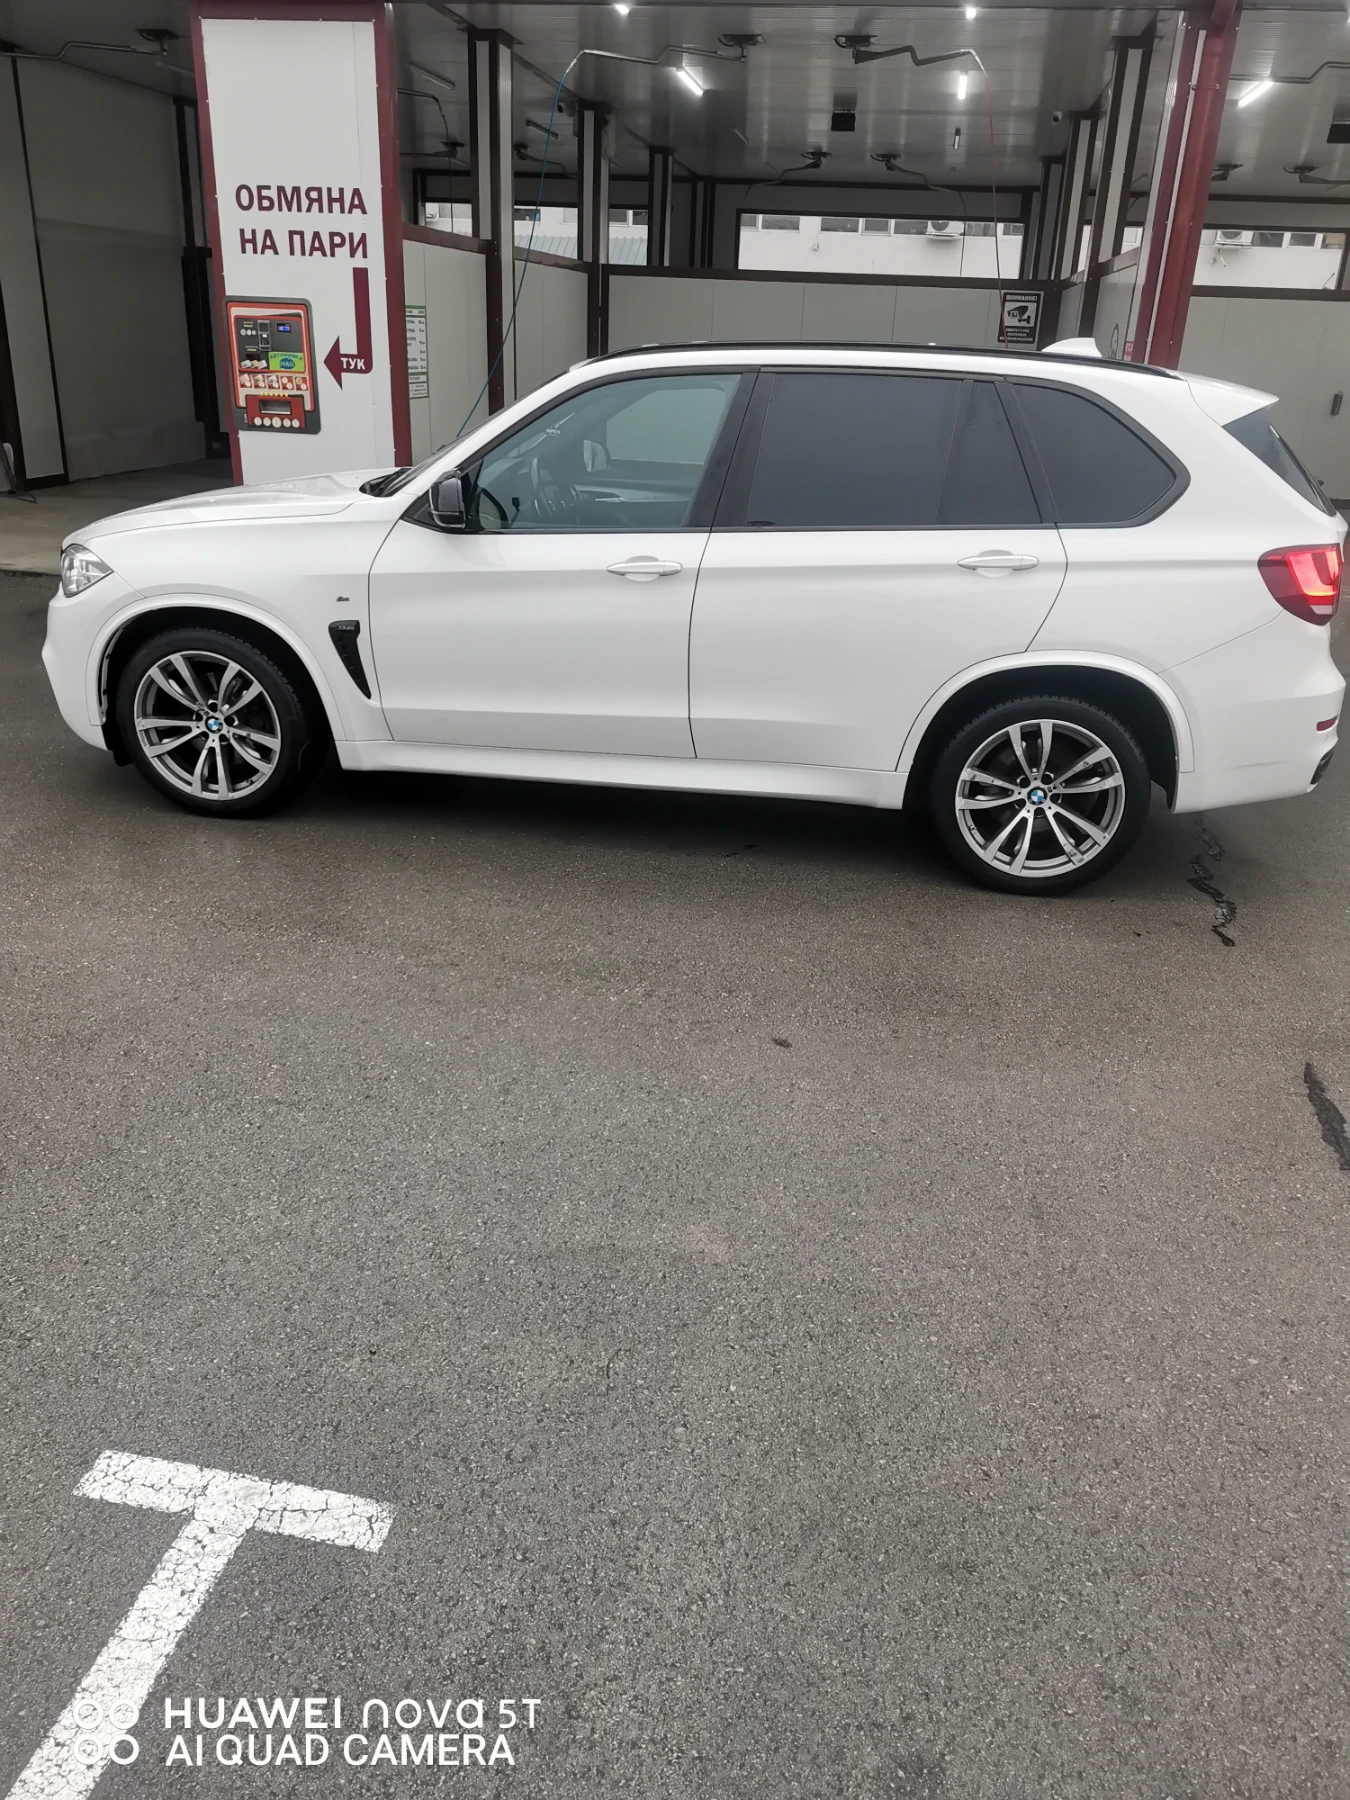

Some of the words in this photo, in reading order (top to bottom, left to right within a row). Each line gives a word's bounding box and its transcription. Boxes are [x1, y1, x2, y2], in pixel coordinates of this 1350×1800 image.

[235, 184, 368, 215] ОБМЯНА
[239, 228, 279, 255] НА
[288, 230, 368, 259] ПАРИ
[340, 357, 366, 370] ТУК
